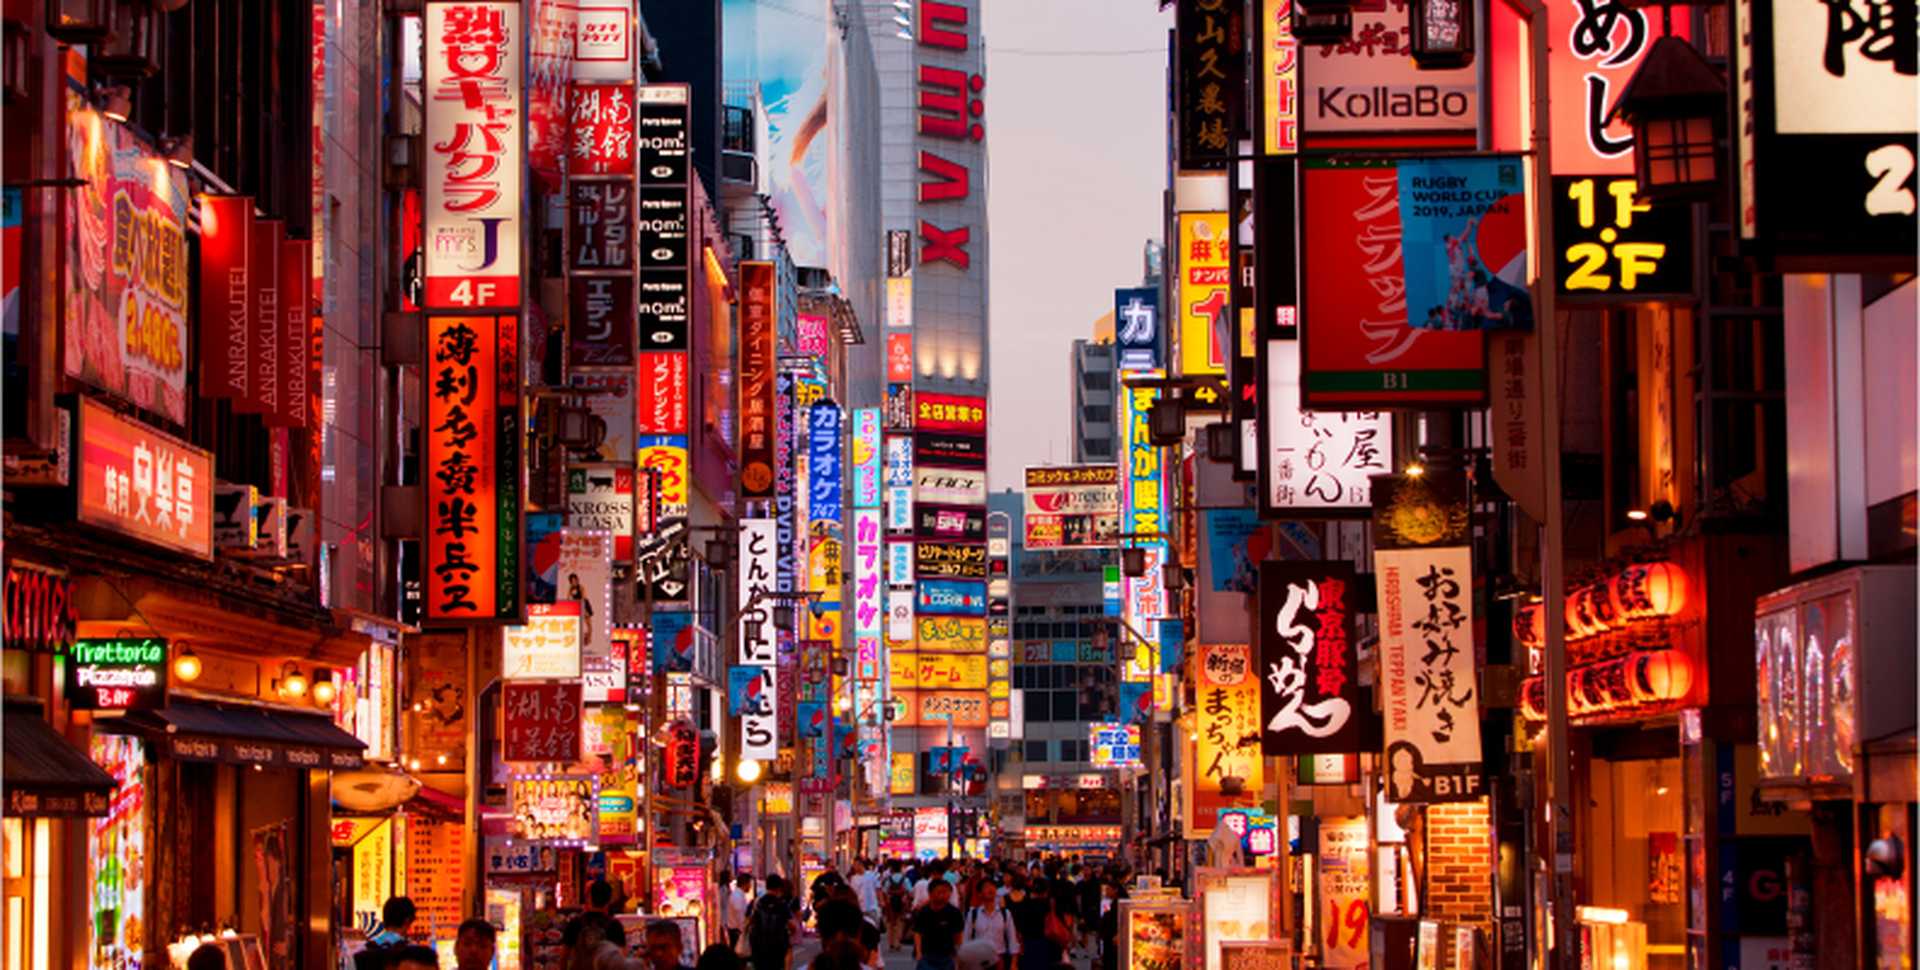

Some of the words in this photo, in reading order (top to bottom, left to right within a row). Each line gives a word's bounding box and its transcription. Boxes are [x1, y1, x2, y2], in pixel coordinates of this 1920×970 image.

[1318, 85, 1468, 118] KollaBo
[1412, 176, 1468, 189] RUGBY
[1412, 190, 1473, 202] WORLD
[1475, 190, 1509, 202] CUP
[1413, 205, 1453, 218] 2019,
[1455, 204, 1510, 217] JAPAN
[457, 217, 512, 272] J
[1565, 243, 1666, 290] 2F
[450, 280, 497, 307] 4F
[228, 265, 246, 391] ANRAKUTEI
[259, 286, 276, 408] ANRAKUTEI
[1383, 373, 1409, 389] B1
[813, 406, 837, 500] カラオケ
[571, 501, 632, 515] XROSS
[811, 503, 837, 517] 747
[577, 517, 625, 530] CASA
[857, 515, 878, 629] カラオケ
[73, 640, 162, 662] Trattoria
[1411, 564, 1473, 744] お好み焼き
[920, 665, 961, 682] ゲーム
[1388, 645, 1409, 731] TEPPANYAKI
[1434, 774, 1480, 795] B1F
